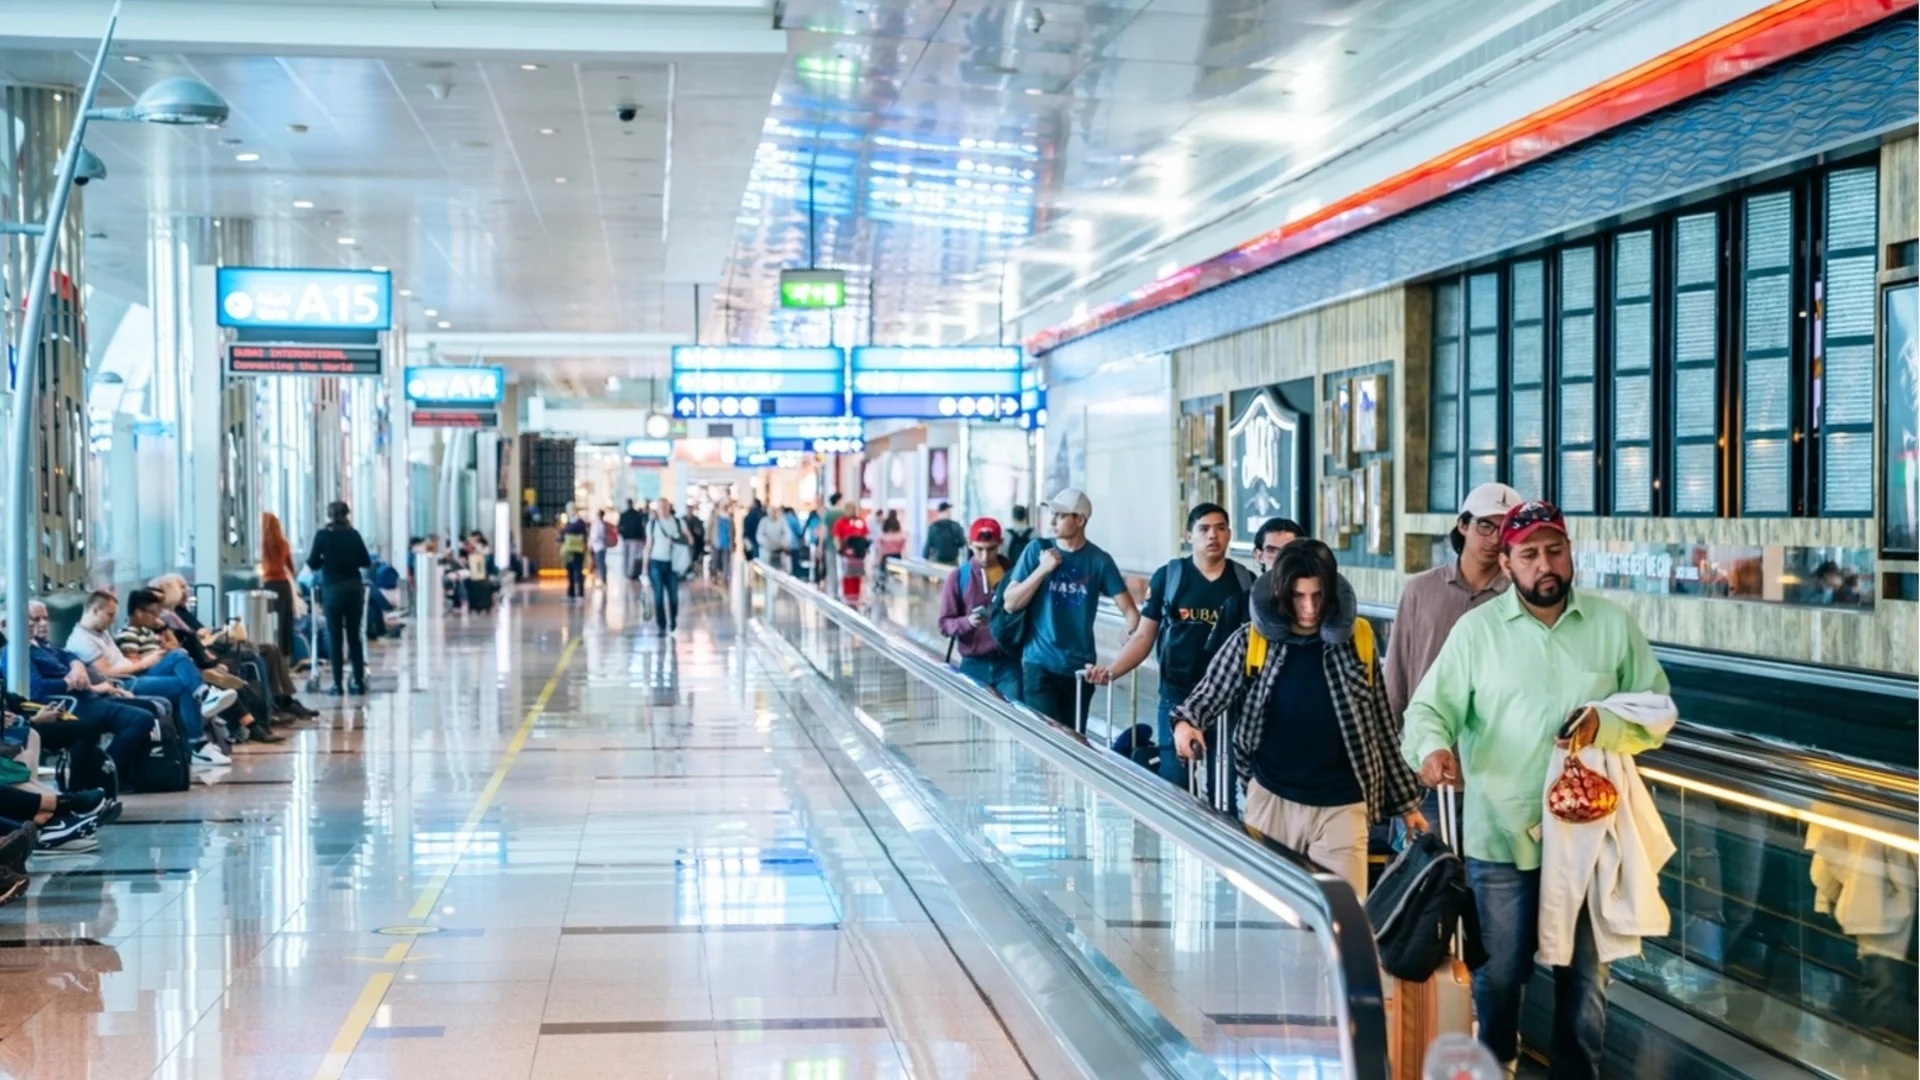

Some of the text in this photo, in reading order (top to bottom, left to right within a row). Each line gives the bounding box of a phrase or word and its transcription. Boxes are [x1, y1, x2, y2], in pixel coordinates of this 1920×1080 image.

[295, 283, 379, 323] A15
[233, 348, 346, 360] DUBAI INTERNATIONAL
[233, 361, 354, 373] Connecting the World
[448, 374, 499, 400] A14
[1049, 581, 1087, 595] NASA
[1178, 607, 1222, 621] DUBA
